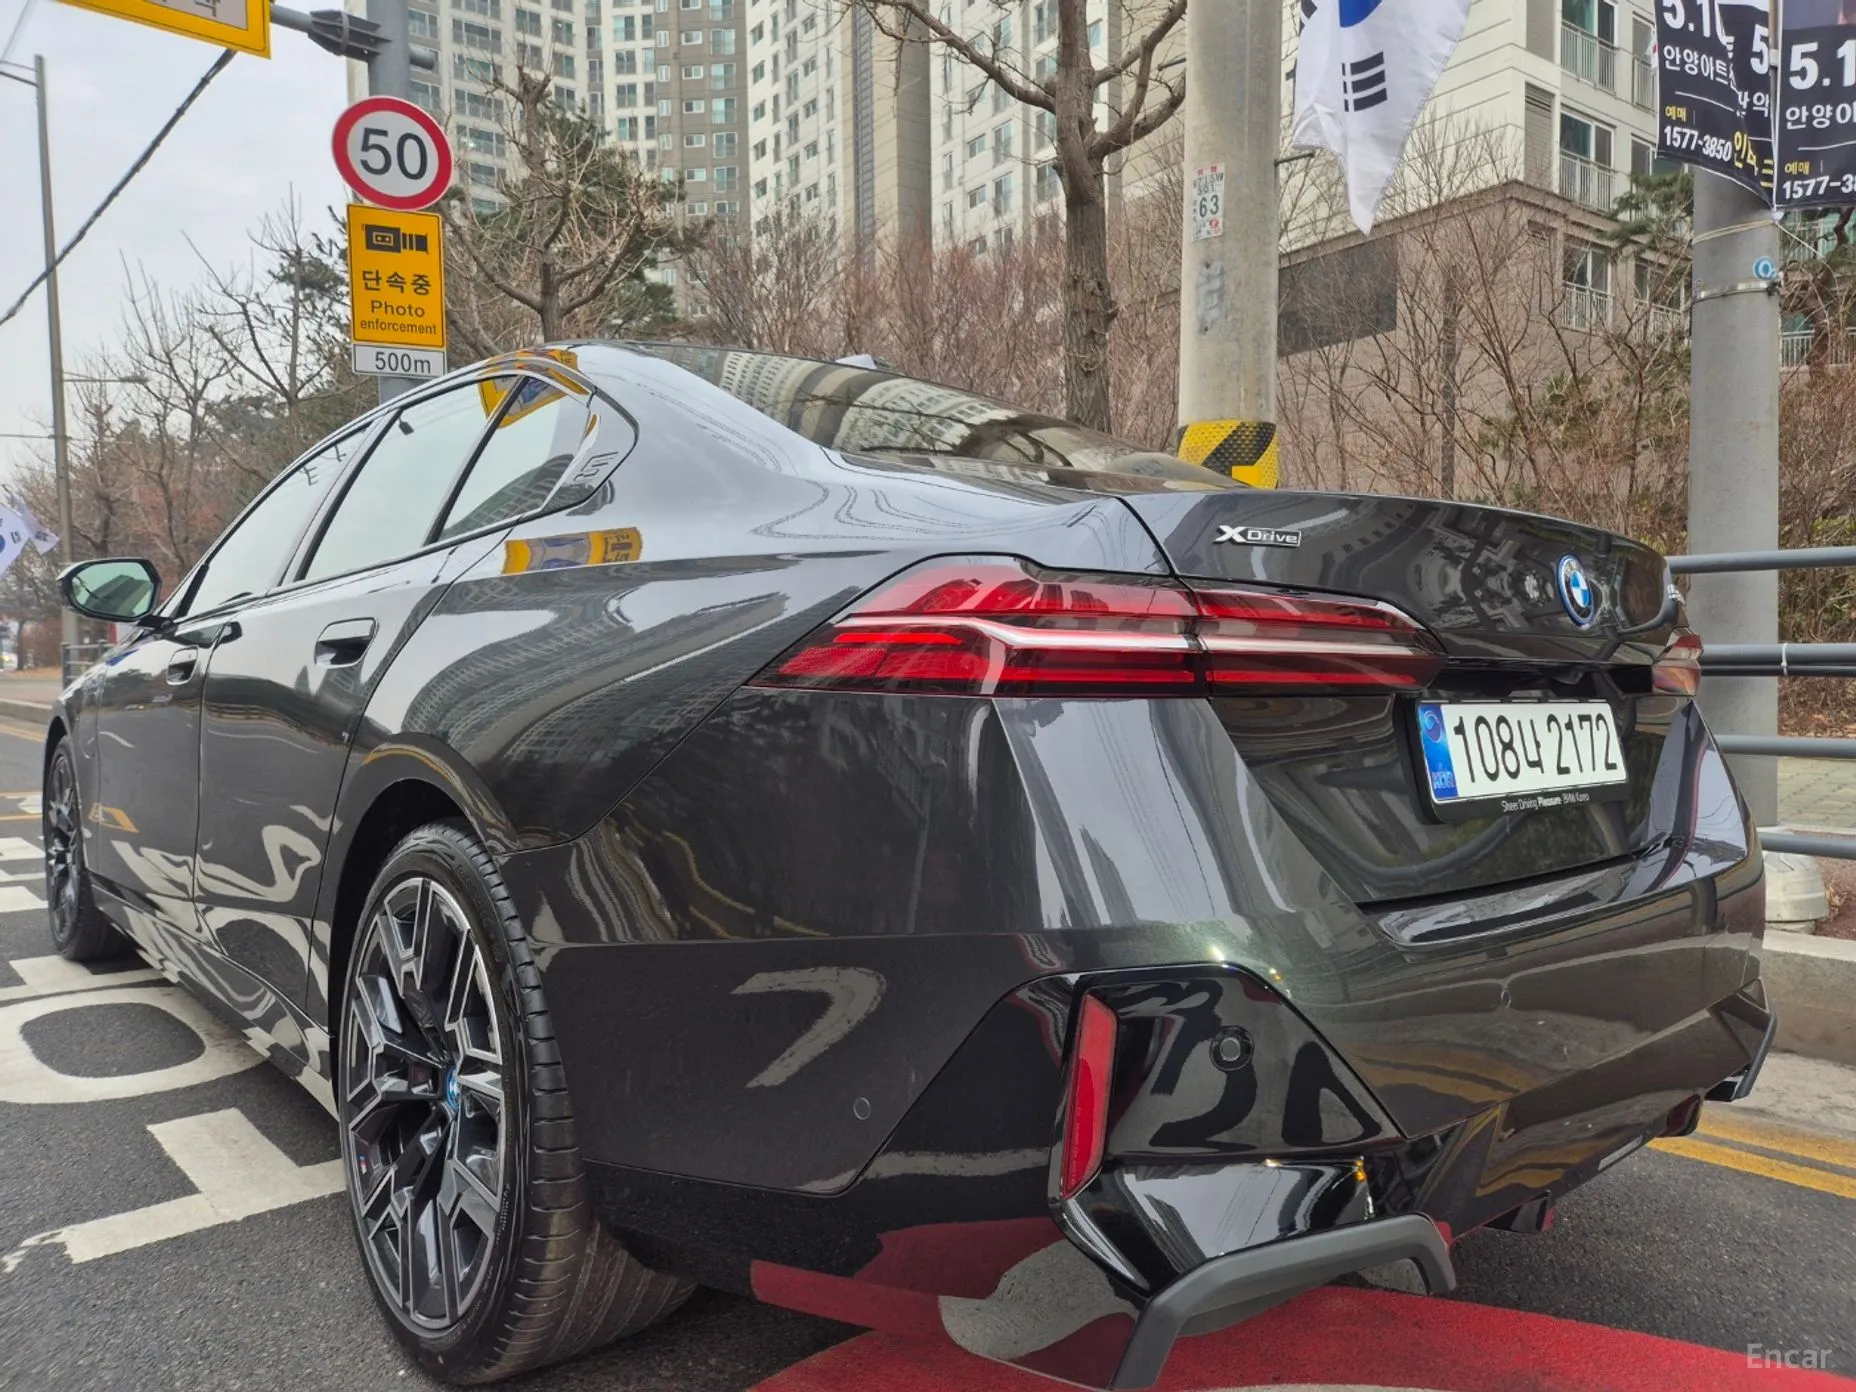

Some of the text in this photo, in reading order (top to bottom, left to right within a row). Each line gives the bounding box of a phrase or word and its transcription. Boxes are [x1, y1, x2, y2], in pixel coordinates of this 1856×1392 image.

[360, 127, 428, 180] 50
[1663, 125, 1733, 162] 1577-3850
[1784, 161, 1810, 175] 예매
[1199, 194, 1219, 218] 63
[362, 269, 431, 296] 단속중
[371, 299, 425, 318] Photo
[360, 318, 437, 335] enforcement
[375, 351, 431, 374] 500m
